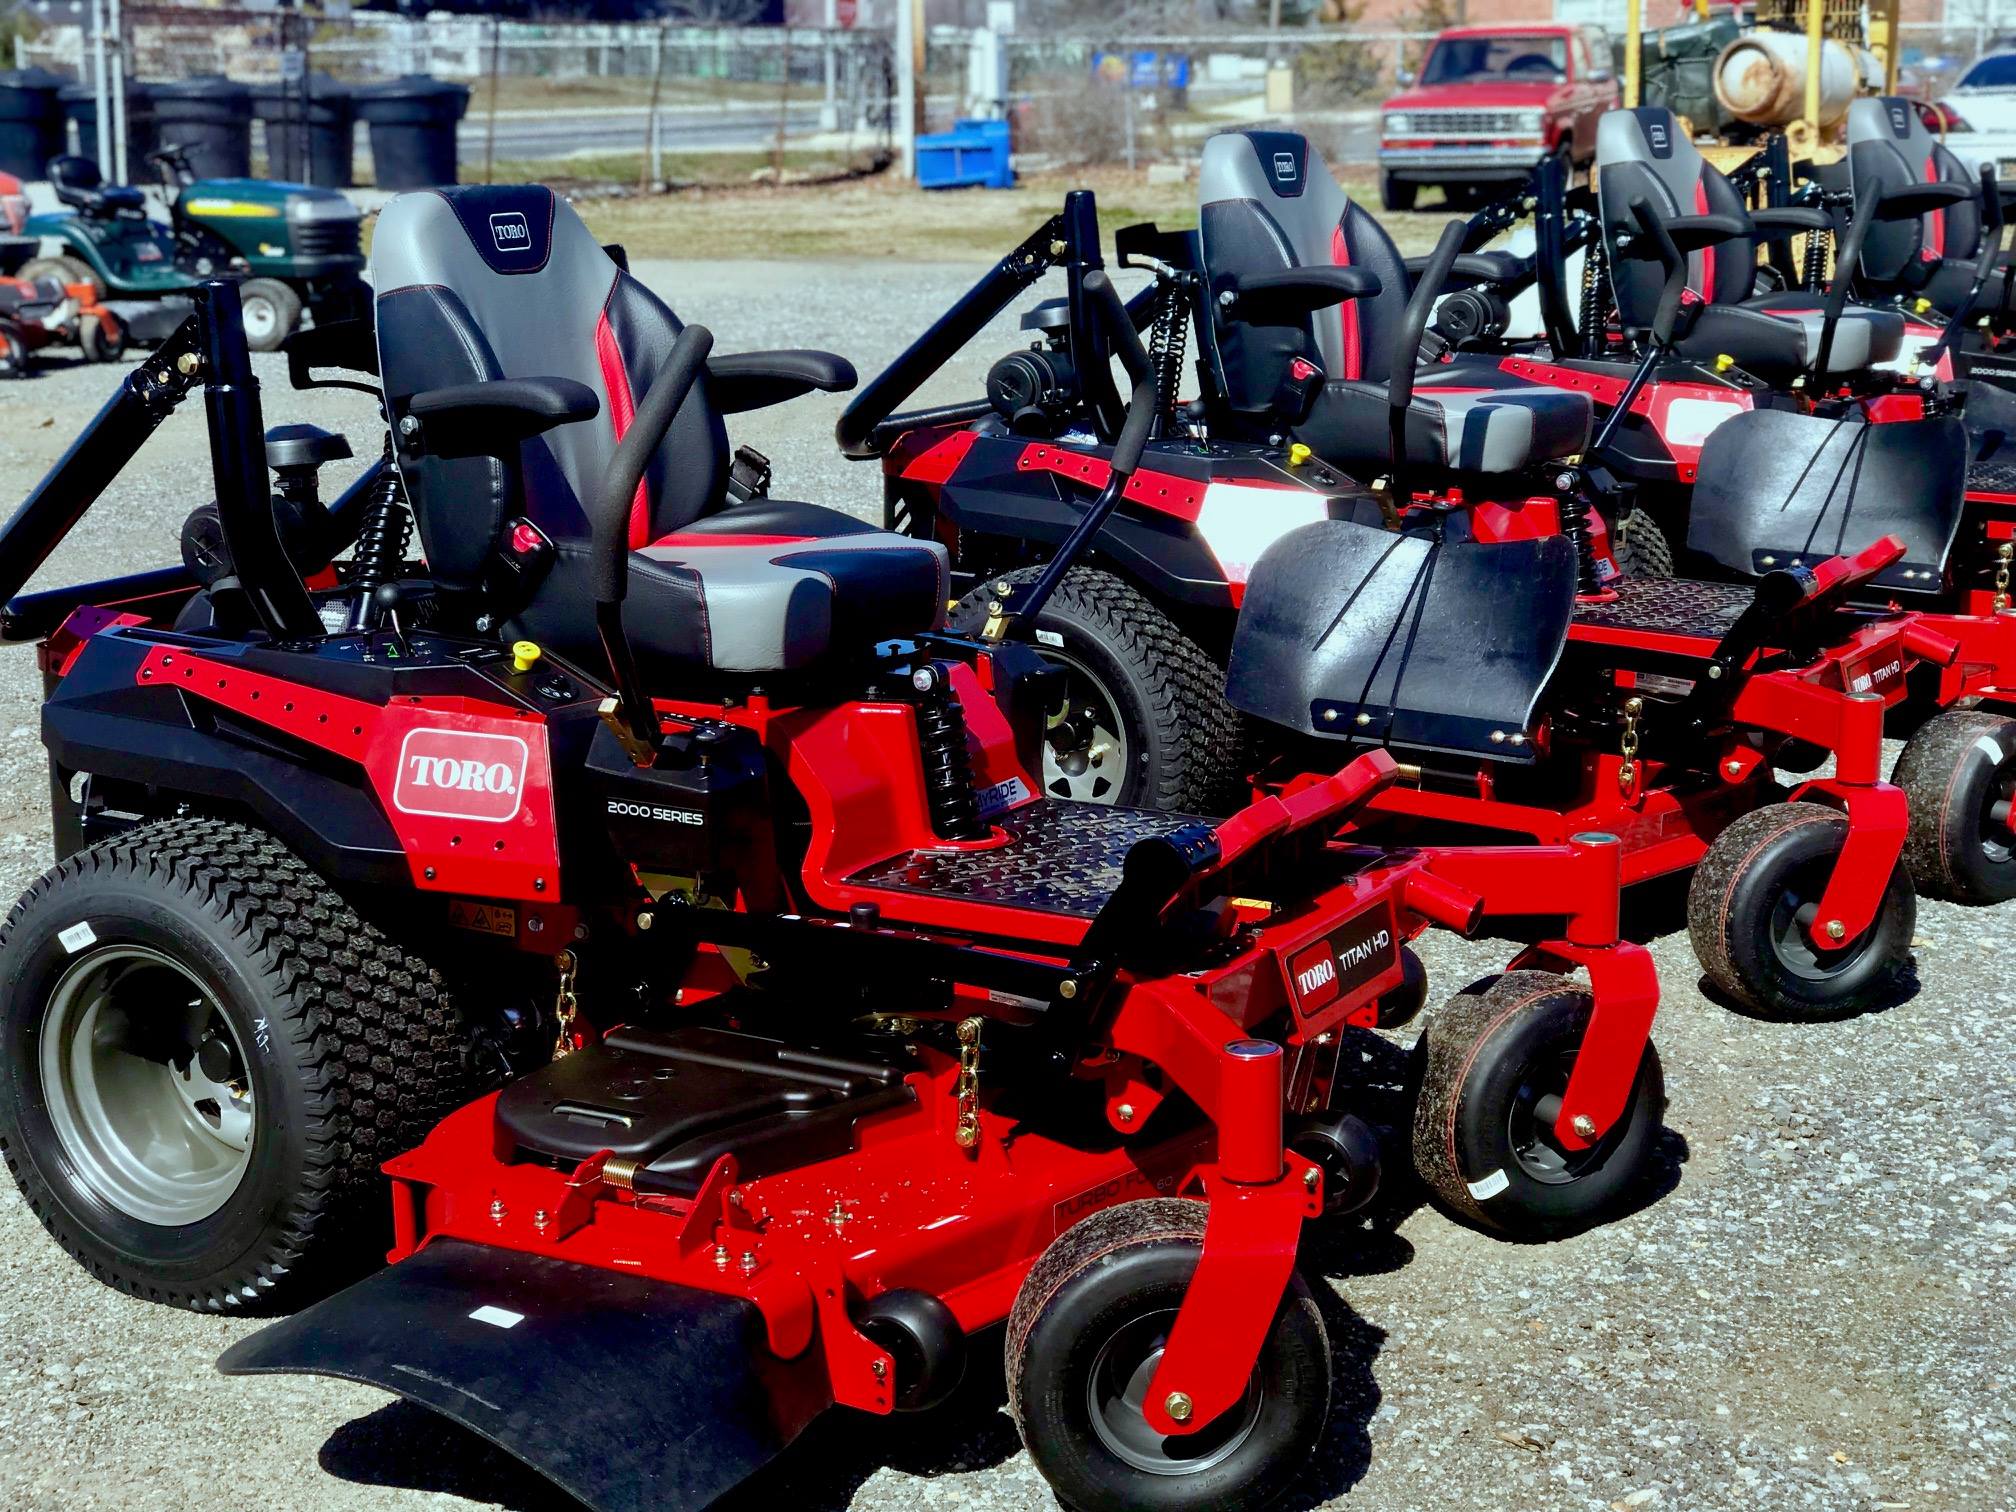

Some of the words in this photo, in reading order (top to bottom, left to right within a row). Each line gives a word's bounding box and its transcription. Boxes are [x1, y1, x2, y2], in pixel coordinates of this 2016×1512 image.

[495, 224, 525, 240] TORO
[1873, 665, 1891, 684] TITAN
[1890, 660, 1900, 675] HD
[607, 801, 650, 818] 2000
[652, 808, 704, 826] SERIES
[1339, 940, 1373, 971] TITAN
[1372, 929, 1389, 952] HD
[1056, 1180, 1120, 1218] TURBO
